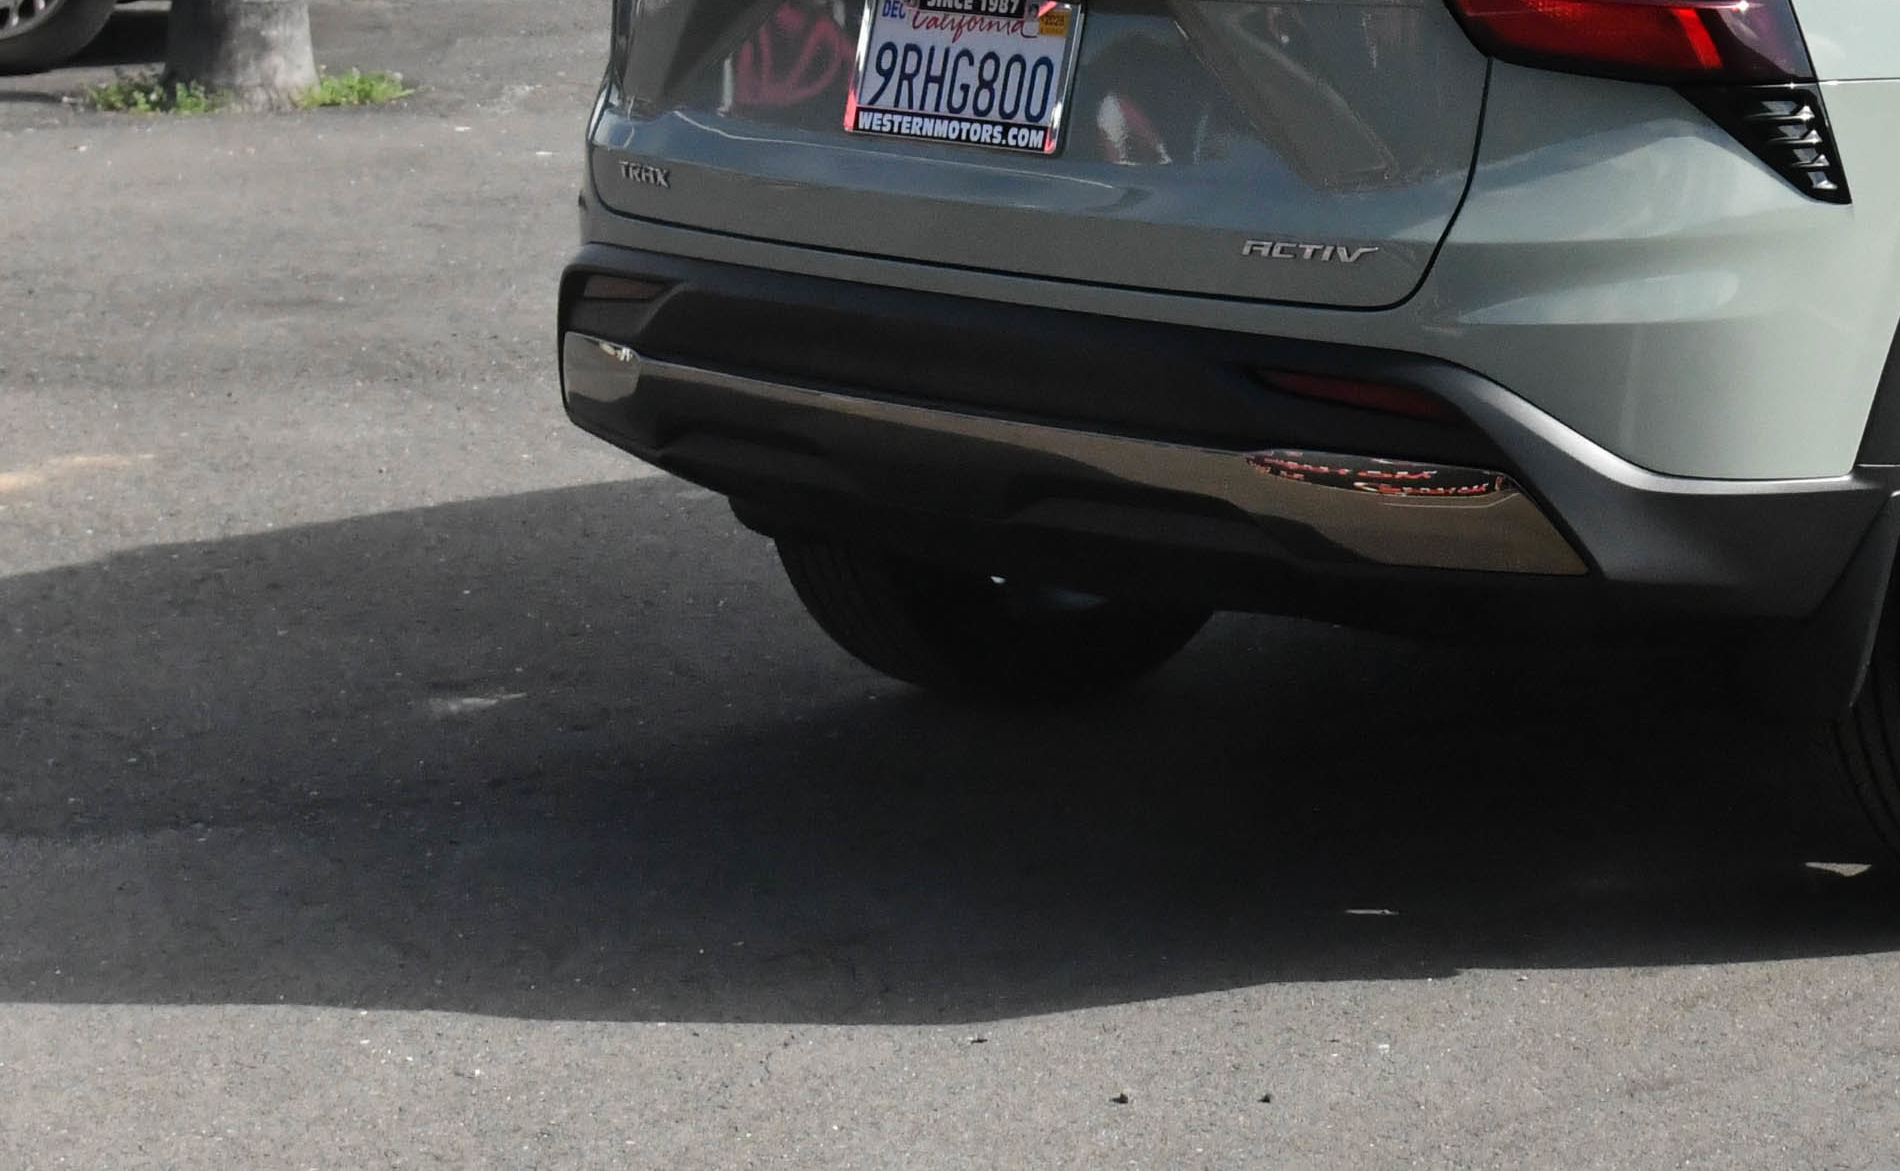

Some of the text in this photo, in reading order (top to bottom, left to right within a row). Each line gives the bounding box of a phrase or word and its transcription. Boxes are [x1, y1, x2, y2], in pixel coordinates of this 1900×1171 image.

[882, 0, 906, 19] DEC
[912, 10, 1038, 43] California
[868, 41, 1054, 123] 9RHG800
[858, 111, 1045, 149] WESTERNMOTORS.COM
[618, 160, 671, 189] TRAX
[1241, 239, 1379, 263] ACTIV
